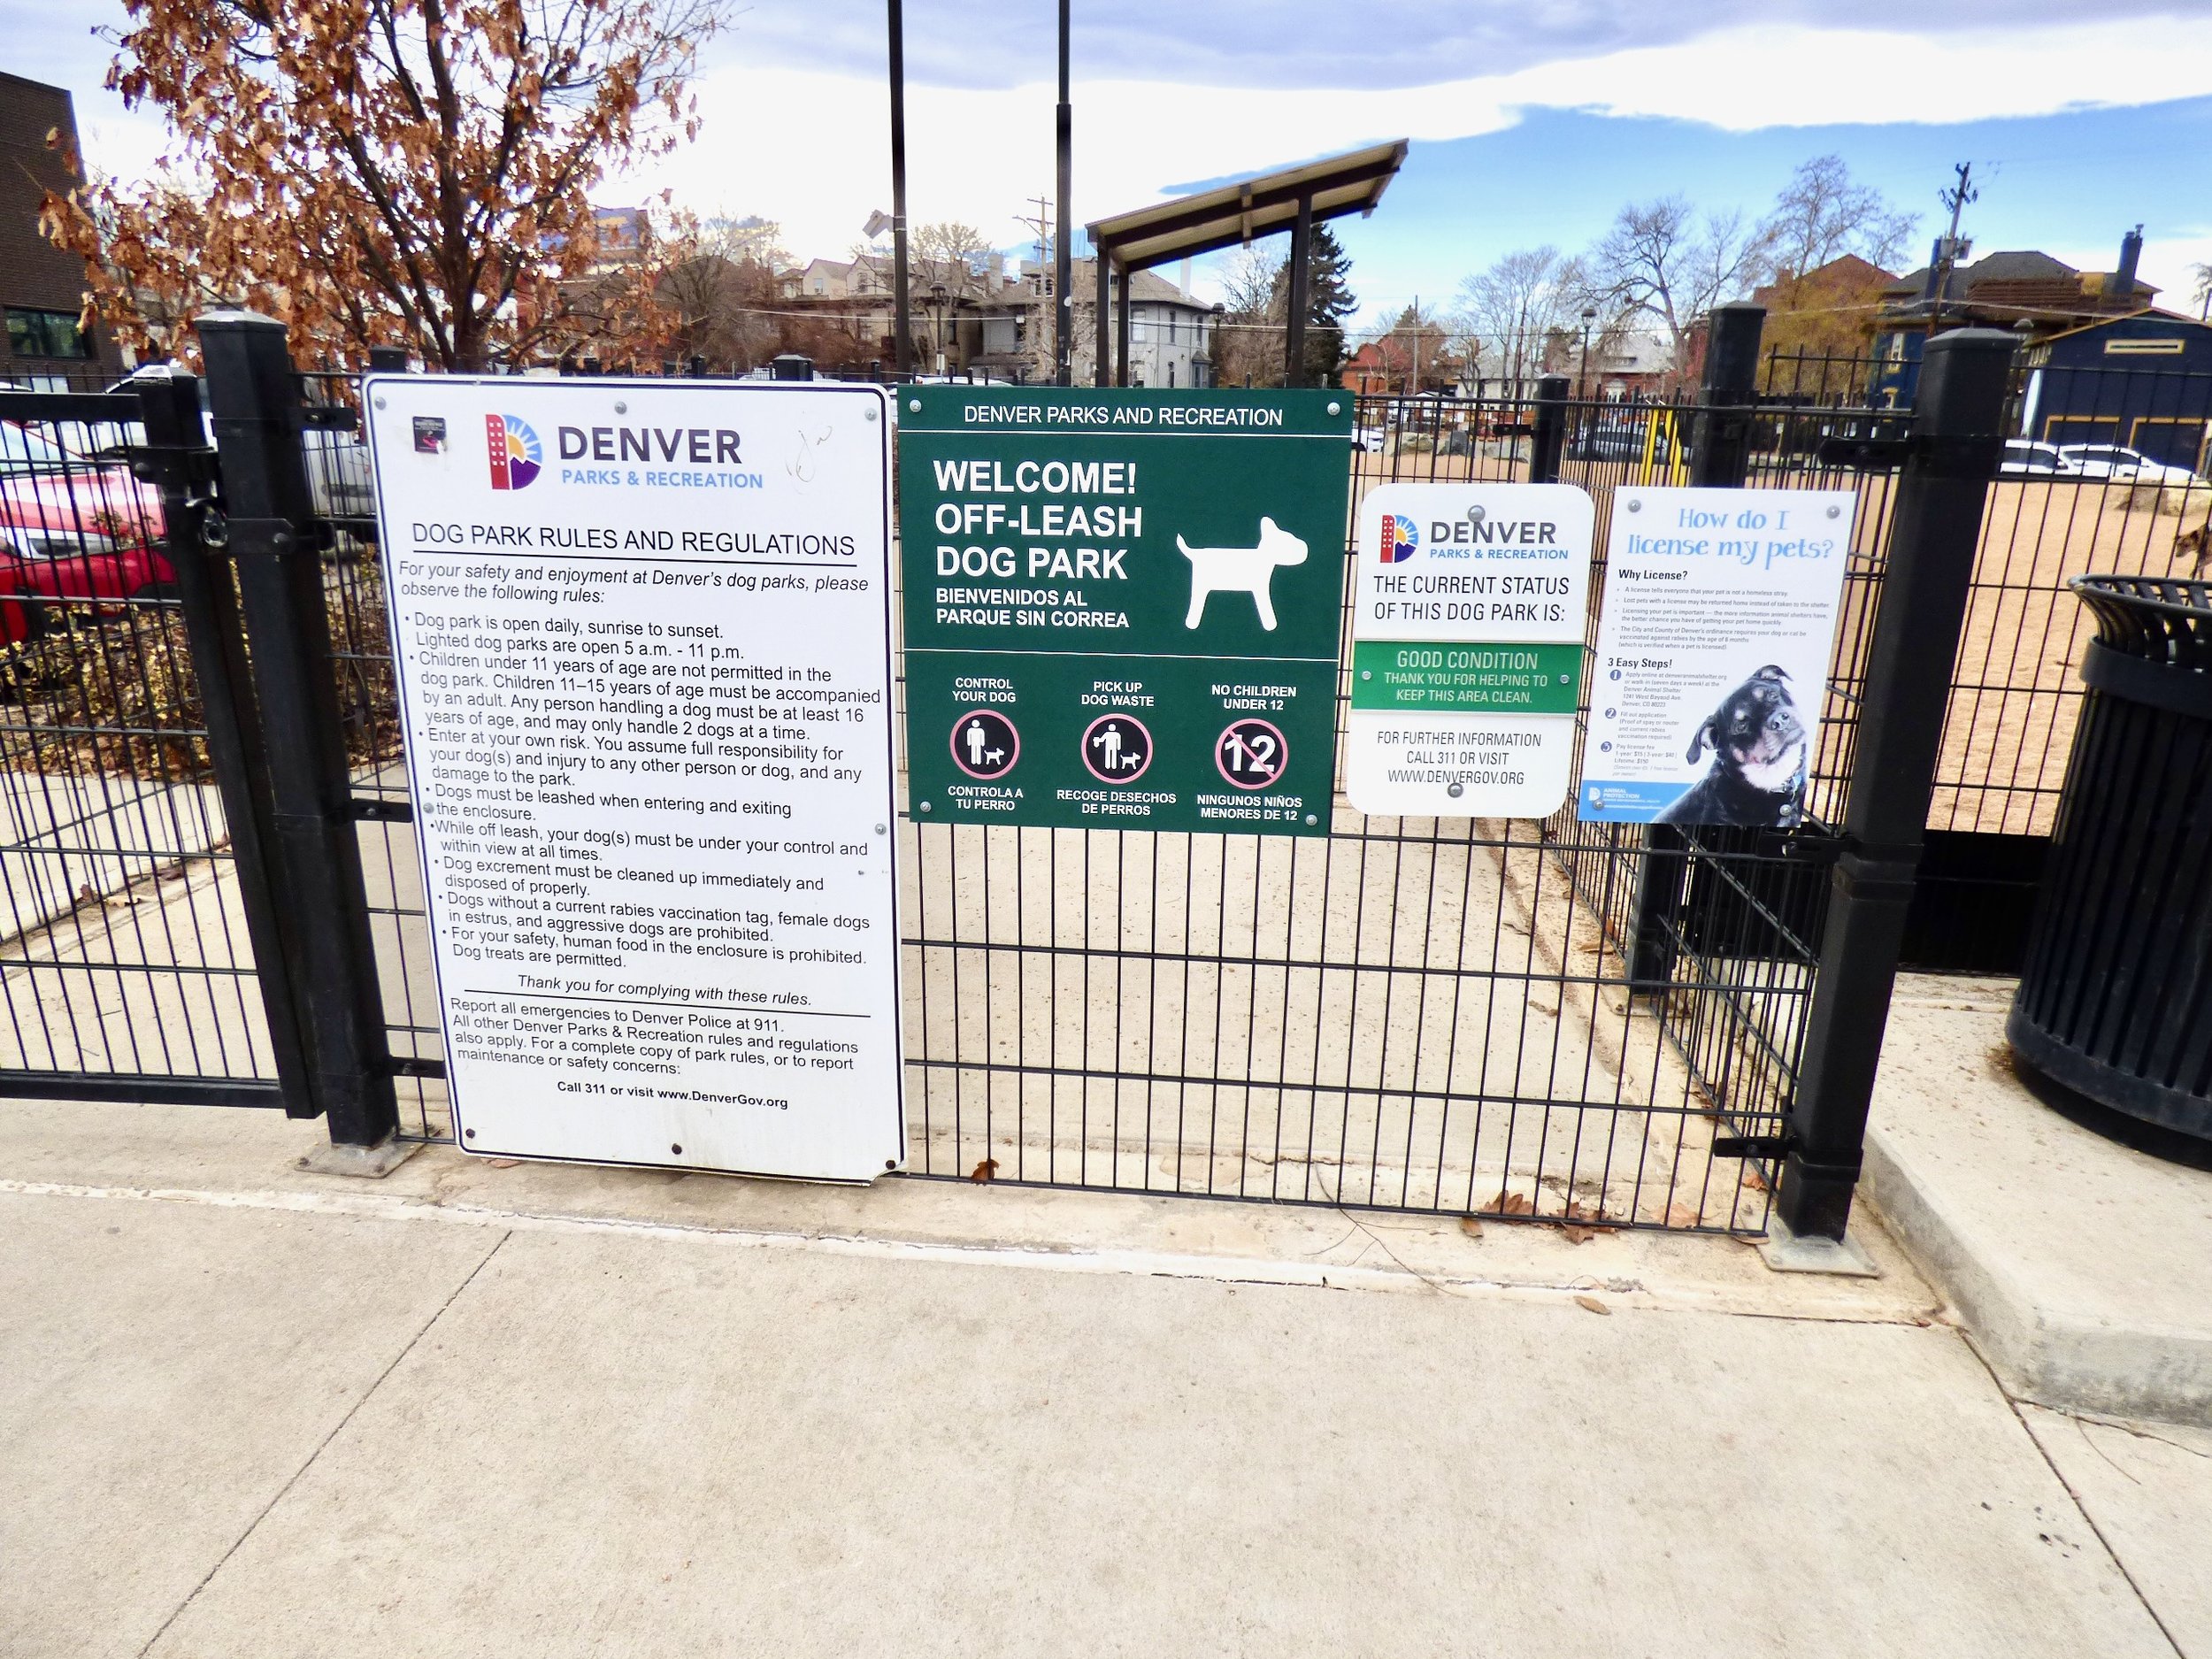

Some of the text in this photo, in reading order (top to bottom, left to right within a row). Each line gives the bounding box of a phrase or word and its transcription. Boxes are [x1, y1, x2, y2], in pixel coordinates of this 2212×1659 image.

[964, 405, 1283, 426] DENVER PARKS AND RECREATION
[558, 426, 742, 465] DENVER
[562, 469, 763, 488] PARKS & RECREATION
[933, 460, 1136, 494] WELCOME!
[935, 503, 1142, 537] OFF-LEASH
[1678, 508, 1791, 530] How do I
[412, 523, 855, 556] DOG PARK RULES AND REGULATIONS
[1431, 521, 1556, 544] DENVER
[1430, 549, 1569, 559] PARKS & RECREATION
[1627, 534, 1833, 571] license my pets?
[937, 546, 1128, 580] DOG PARK
[399, 560, 869, 593] For your safety and enjoyment at Denver's dog parks, please
[1618, 569, 1688, 581] Why License?
[1373, 575, 1570, 595] THE CURRENT STATUS
[936, 588, 1088, 606] BIENVENIDOS AL
[936, 608, 1130, 628] PARQUE SIN CORREA
[1375, 602, 1565, 621] OF THIS DOG PARK IS:
[414, 611, 723, 639] Dog park is open daily, sunrise to sunset.
[1397, 650, 1538, 670] GOOD CONDITION
[1608, 657, 1672, 671] 3 Easy Steps!
[955, 677, 1013, 689] CONTROL
[1094, 681, 1143, 693] PICK UP
[1384, 672, 1548, 687] THANK YOU FOR HELPING TO
[952, 690, 1016, 703] YOUR DOG
[1211, 684, 1297, 697] NO CHILDREN
[1396, 688, 1532, 703] KEEP THIS AREA CLEAN.
[1081, 694, 1154, 707] DOG WASTE
[1223, 698, 1284, 710] UNDER 12
[1378, 731, 1541, 747] FOR FURTHER INFORMATION
[1225, 734, 1276, 772] 12
[1407, 750, 1509, 765] CALL 311 OR VISIT
[1387, 770, 1525, 785] WWW.DENVERGOV.ORG
[948, 786, 1024, 798] CONTROLA A
[1056, 789, 1177, 803] RECOGE DESECHOS
[955, 798, 1015, 811] TU PERRO
[1081, 803, 1150, 816] DE PERROS
[1197, 795, 1302, 808] NINGUNOS NIÑOS
[1201, 807, 1298, 820] MENORES DE 12
[518, 974, 811, 1006] Thank you for complying with these rules.
[450, 997, 784, 1033] Report all emergencies to Denver Police at 911.
[557, 1081, 581, 1093] Call
[585, 1083, 605, 1094] 311
[626, 1087, 654, 1098] visit
[657, 1090, 787, 1110] www.DenverGov.org
